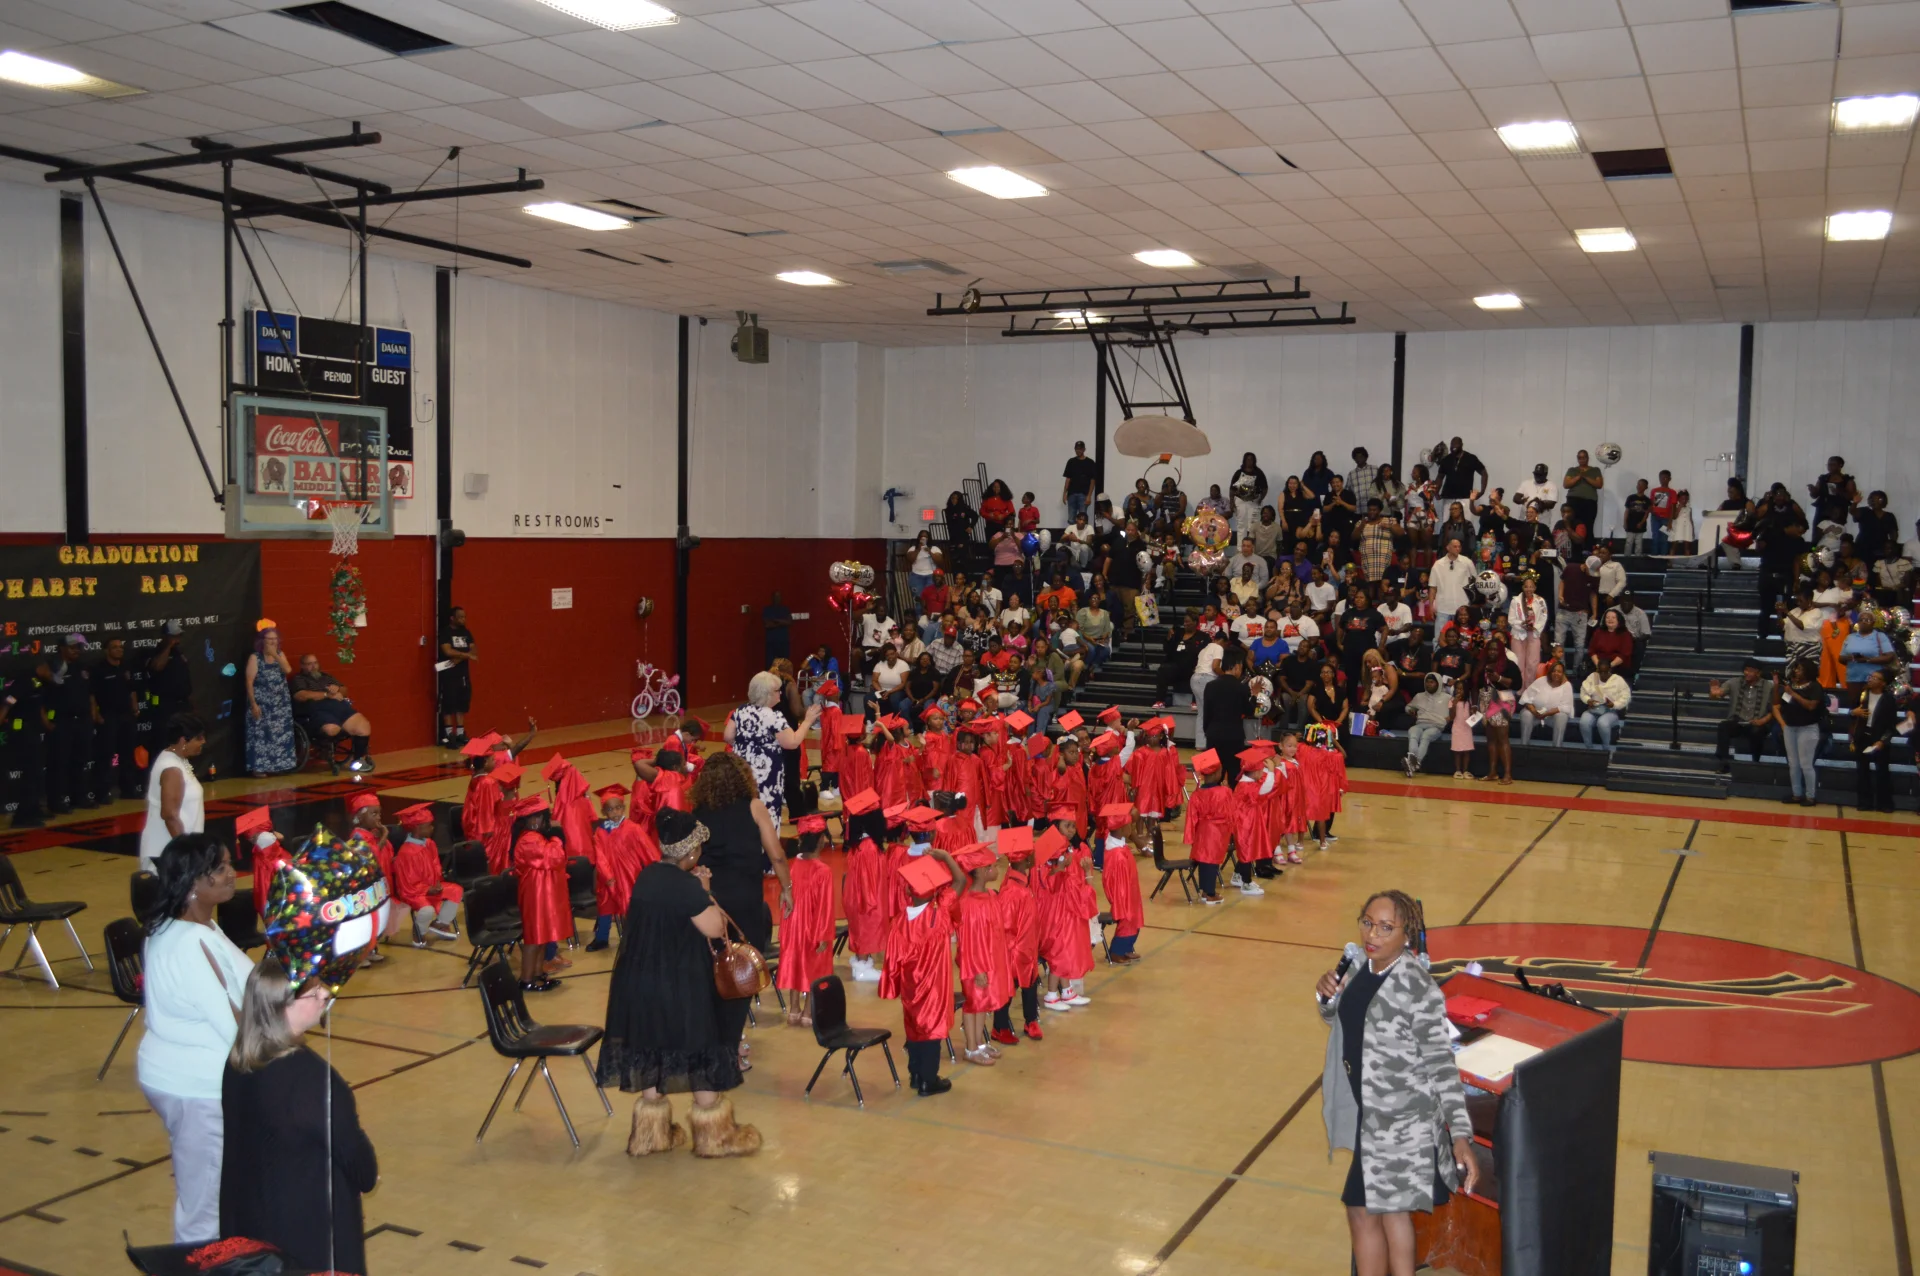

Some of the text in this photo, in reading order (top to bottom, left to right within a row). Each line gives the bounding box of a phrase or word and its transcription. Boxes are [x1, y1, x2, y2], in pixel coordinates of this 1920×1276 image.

[262, 326, 291, 340] DASNI
[381, 342, 407, 356] DASANI
[324, 370, 352, 384] PERIOD
[371, 367, 406, 386] GUEST
[514, 514, 600, 528] RESTROOMS
[59, 544, 199, 565] GRADUATION
[140, 574, 189, 594] RAP
[28, 623, 98, 636] KINDERGARTEN
[104, 621, 123, 631] WILL
[127, 620, 138, 630] BE
[141, 619, 156, 629] THE
[186, 616, 201, 626] FOR
[204, 614, 219, 624] ME!
